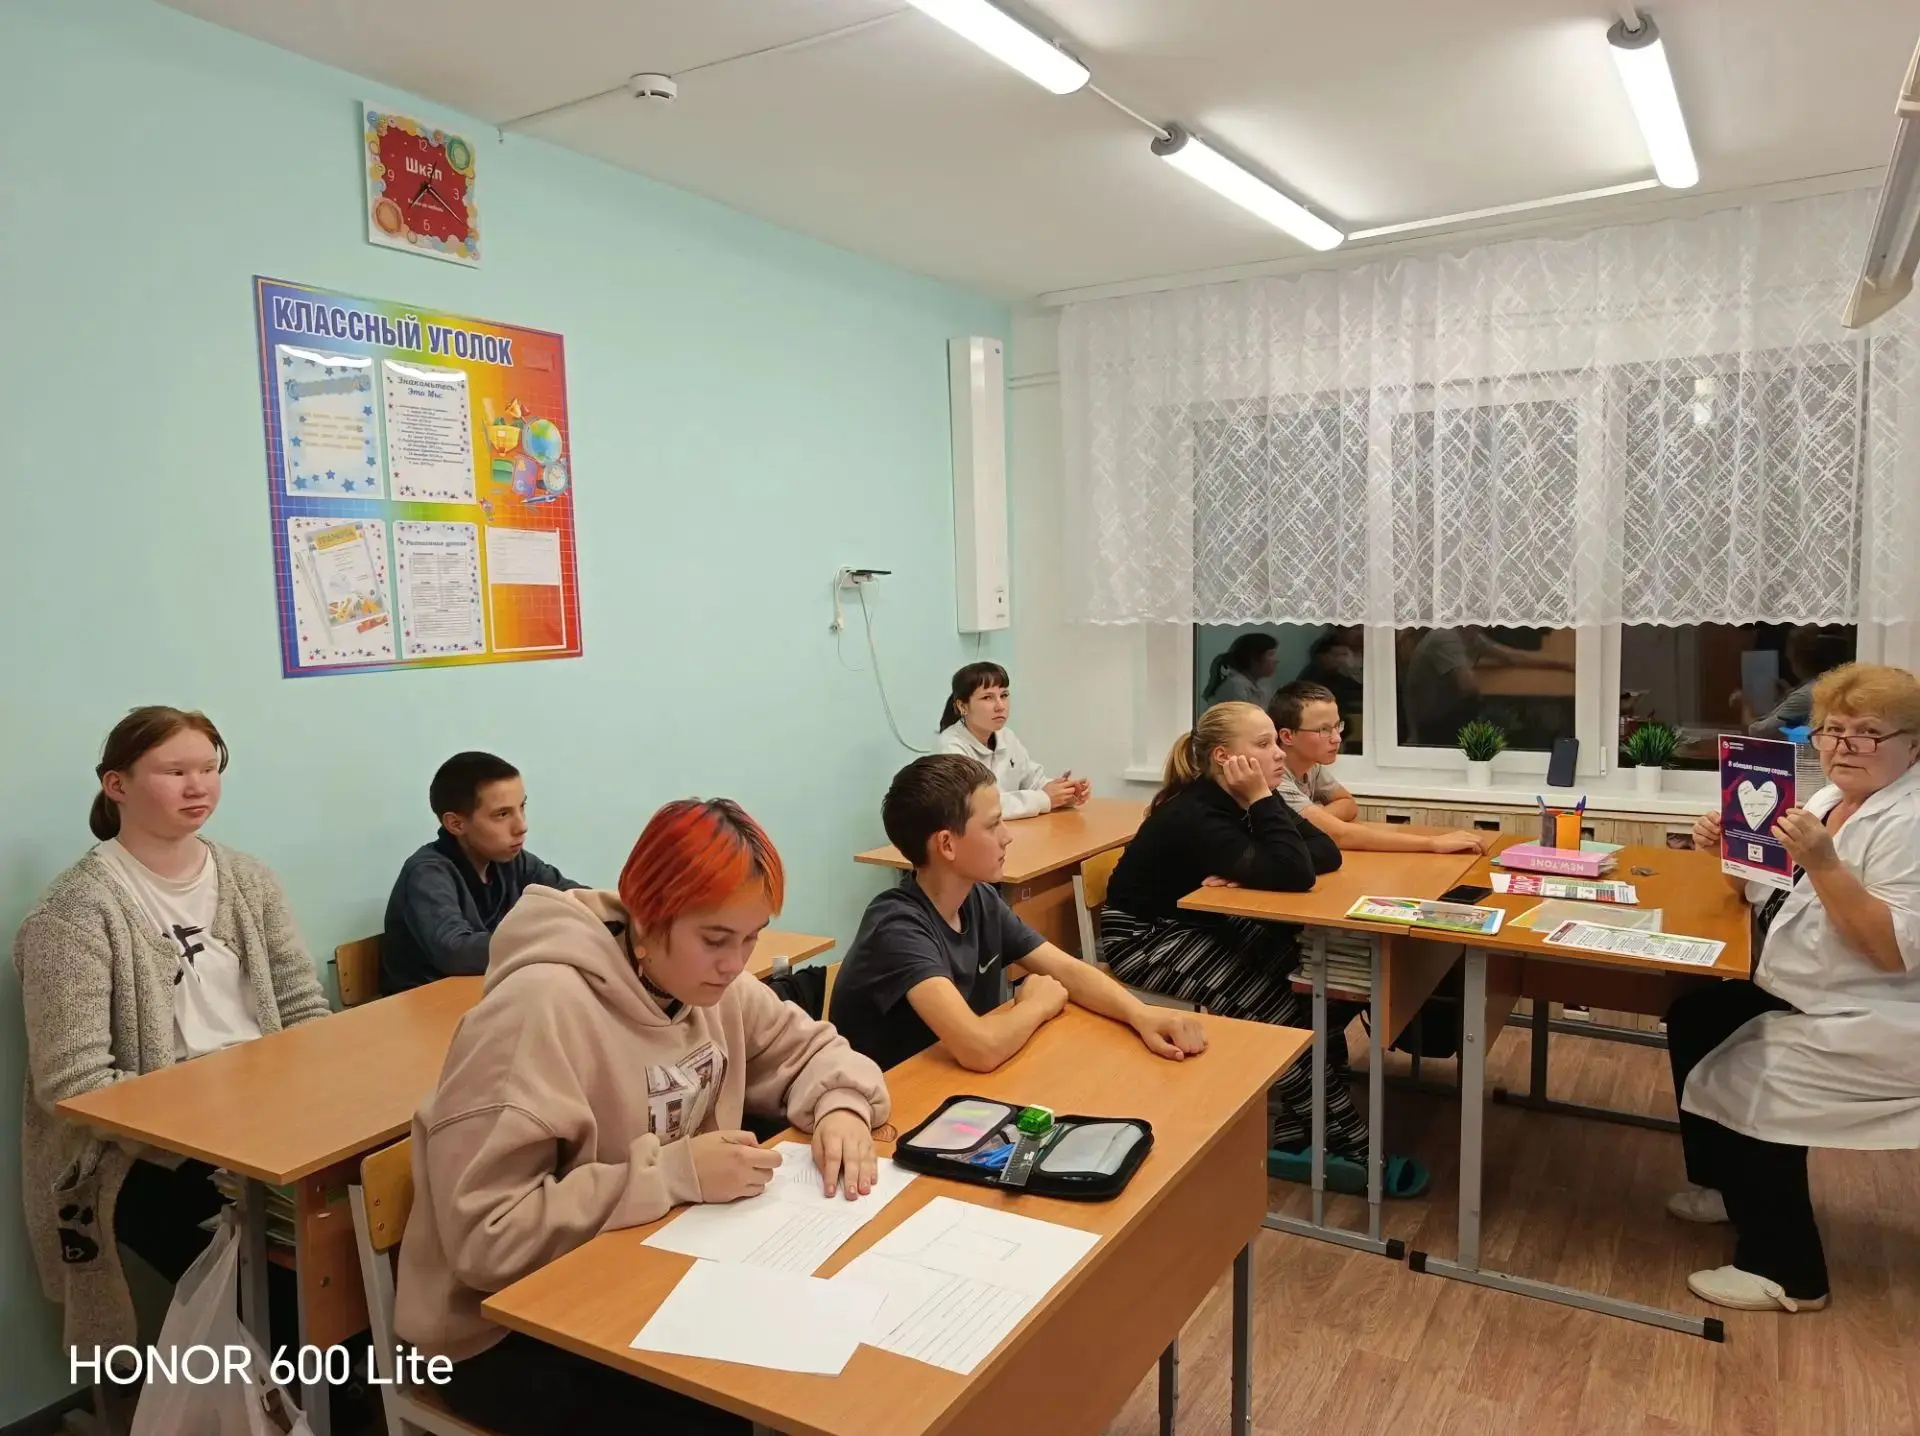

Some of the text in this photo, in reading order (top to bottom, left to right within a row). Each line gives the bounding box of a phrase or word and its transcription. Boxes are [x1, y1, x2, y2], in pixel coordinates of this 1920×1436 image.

[419, 139, 428, 152] 12
[387, 169, 395, 181] 9
[452, 188, 460, 200] 3
[423, 219, 431, 231] 6
[273, 296, 514, 367] КЛАССНЫЙ УГОЛОК
